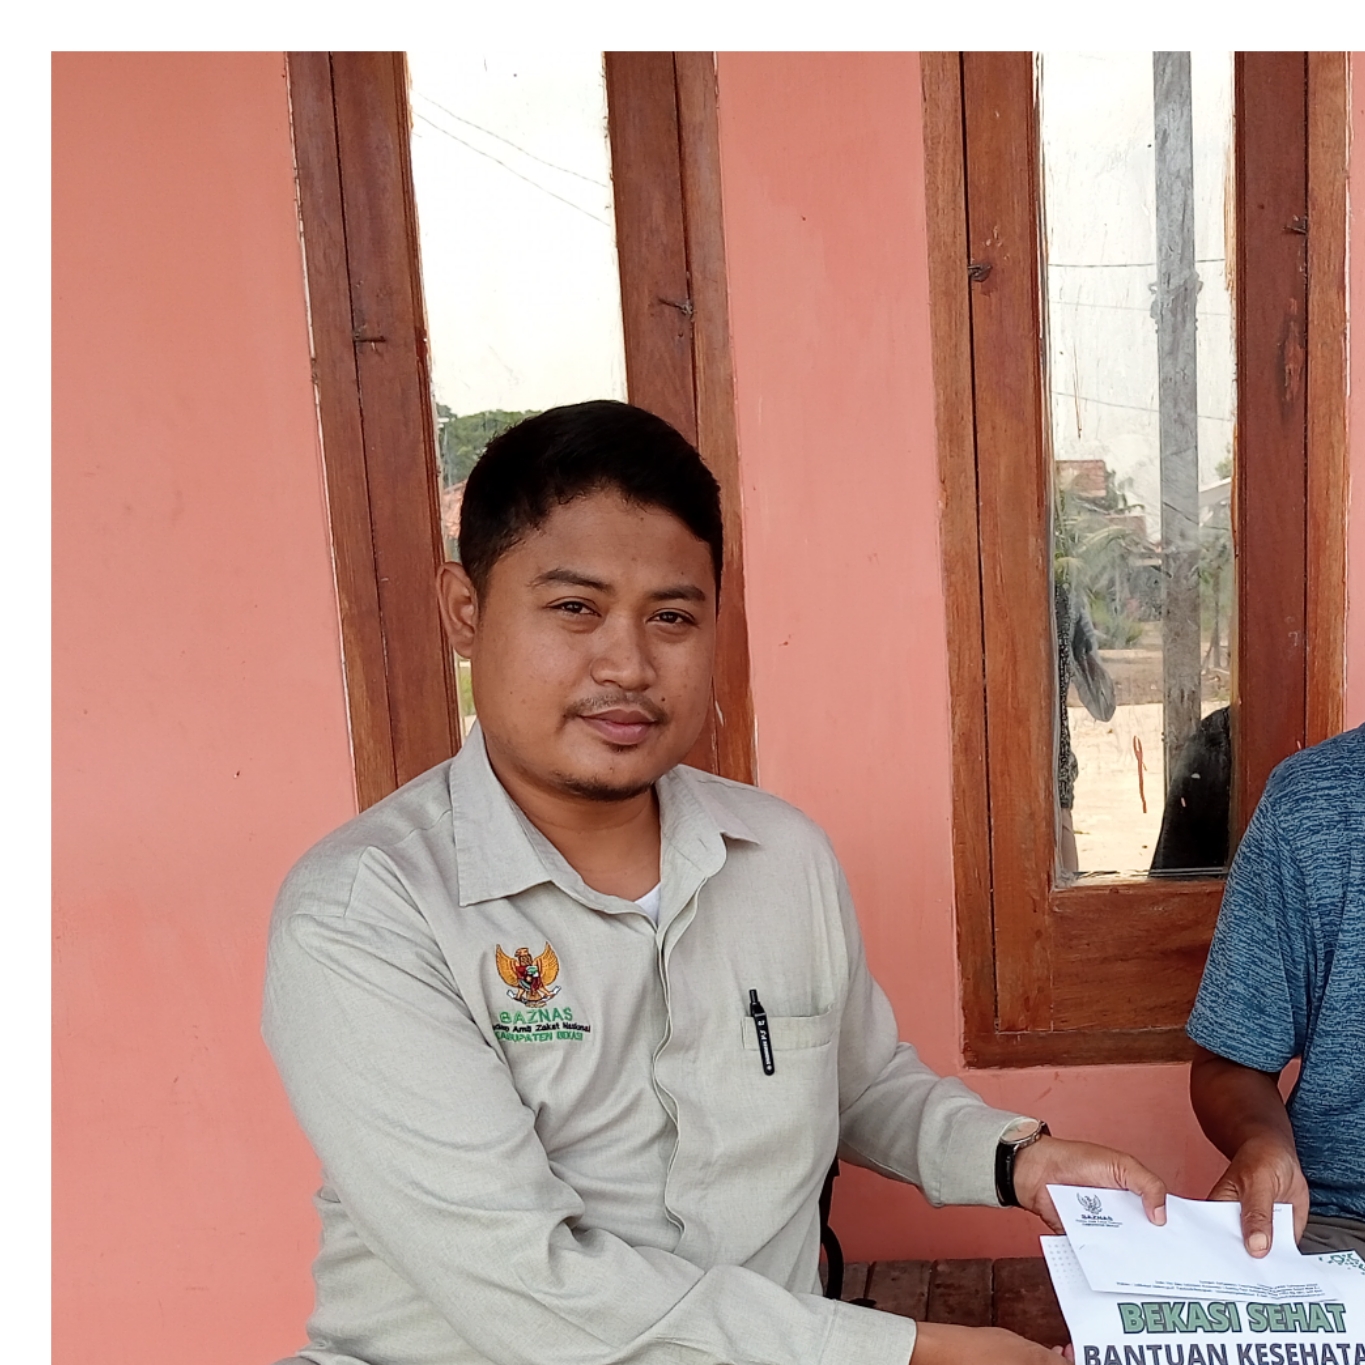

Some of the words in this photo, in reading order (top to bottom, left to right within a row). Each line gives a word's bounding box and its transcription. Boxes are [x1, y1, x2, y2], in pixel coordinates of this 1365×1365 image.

[500, 1007, 573, 1024] BAZNAS
[1118, 1302, 1240, 1333] BEKASI
[1248, 1302, 1347, 1333] SEHAT
